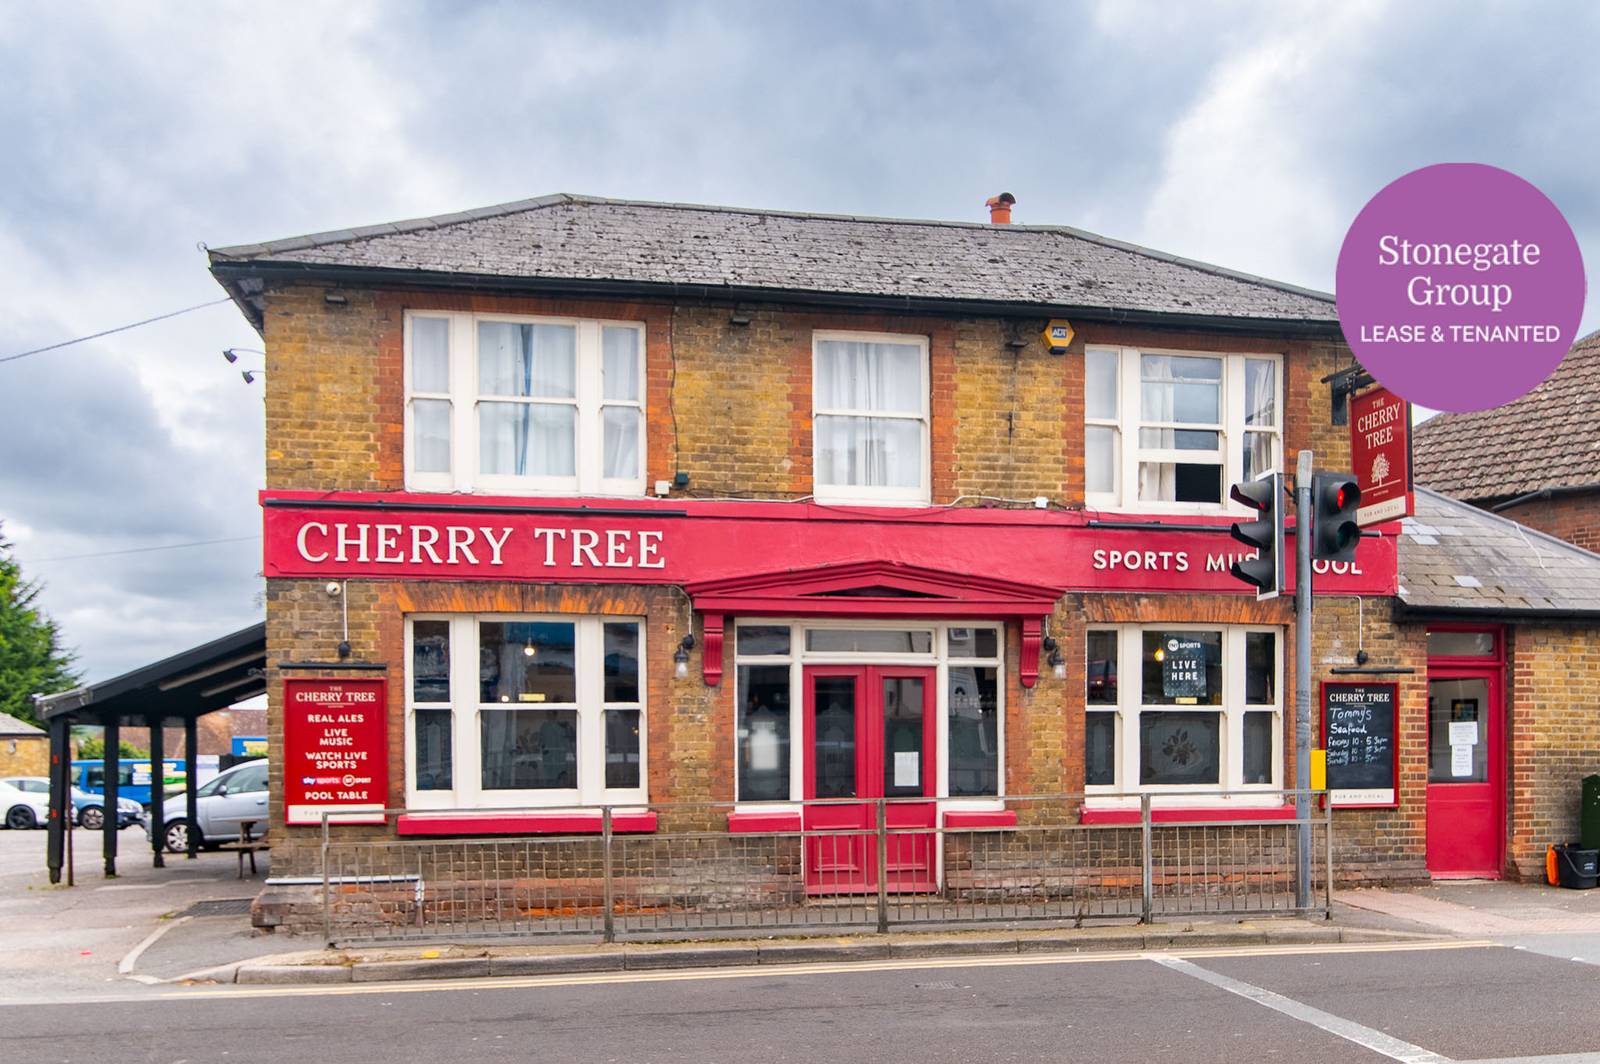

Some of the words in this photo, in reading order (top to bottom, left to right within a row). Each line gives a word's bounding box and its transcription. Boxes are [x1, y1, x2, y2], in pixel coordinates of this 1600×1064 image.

[1372, 397, 1384, 409] THE
[1357, 402, 1400, 433] CHERRY
[1365, 425, 1393, 449] TREE
[296, 521, 513, 565] CHERRY
[534, 527, 665, 569] TREE
[1092, 549, 1189, 572] SPORTS
[1172, 660, 1197, 670] LIVE
[1171, 672, 1198, 681] HERE
[296, 692, 342, 702] CHERRY
[345, 692, 376, 702] TREE
[1329, 693, 1364, 702] CHERRY
[1367, 693, 1390, 702] TREE
[307, 714, 335, 723] REAL
[337, 714, 364, 723] ALES
[324, 728, 348, 737] LIVE
[319, 737, 353, 746] MUSIC
[305, 751, 342, 760] WATCH
[344, 751, 368, 760] LIVE
[316, 760, 357, 769] SPORTS
[305, 791, 334, 800] POOL
[336, 791, 368, 800] TABLE
